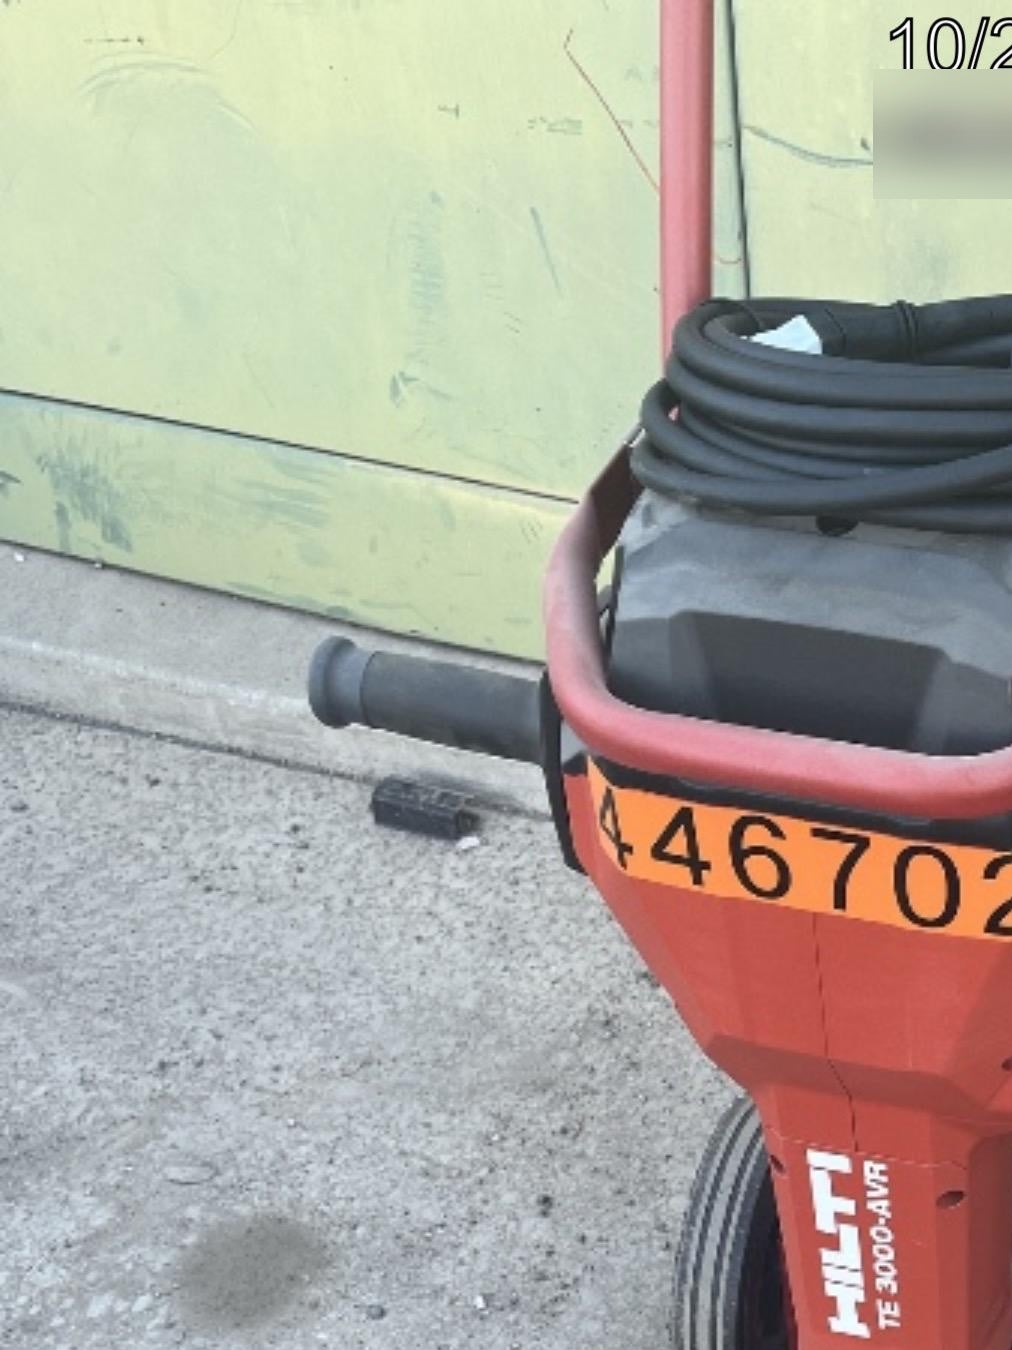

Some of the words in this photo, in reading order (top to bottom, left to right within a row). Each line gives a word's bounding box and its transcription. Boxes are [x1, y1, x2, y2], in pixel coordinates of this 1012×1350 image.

[806, 1148, 871, 1339] HILTI
[863, 1160, 898, 1295] 3000-AVR
[876, 1298, 901, 1329] TE
